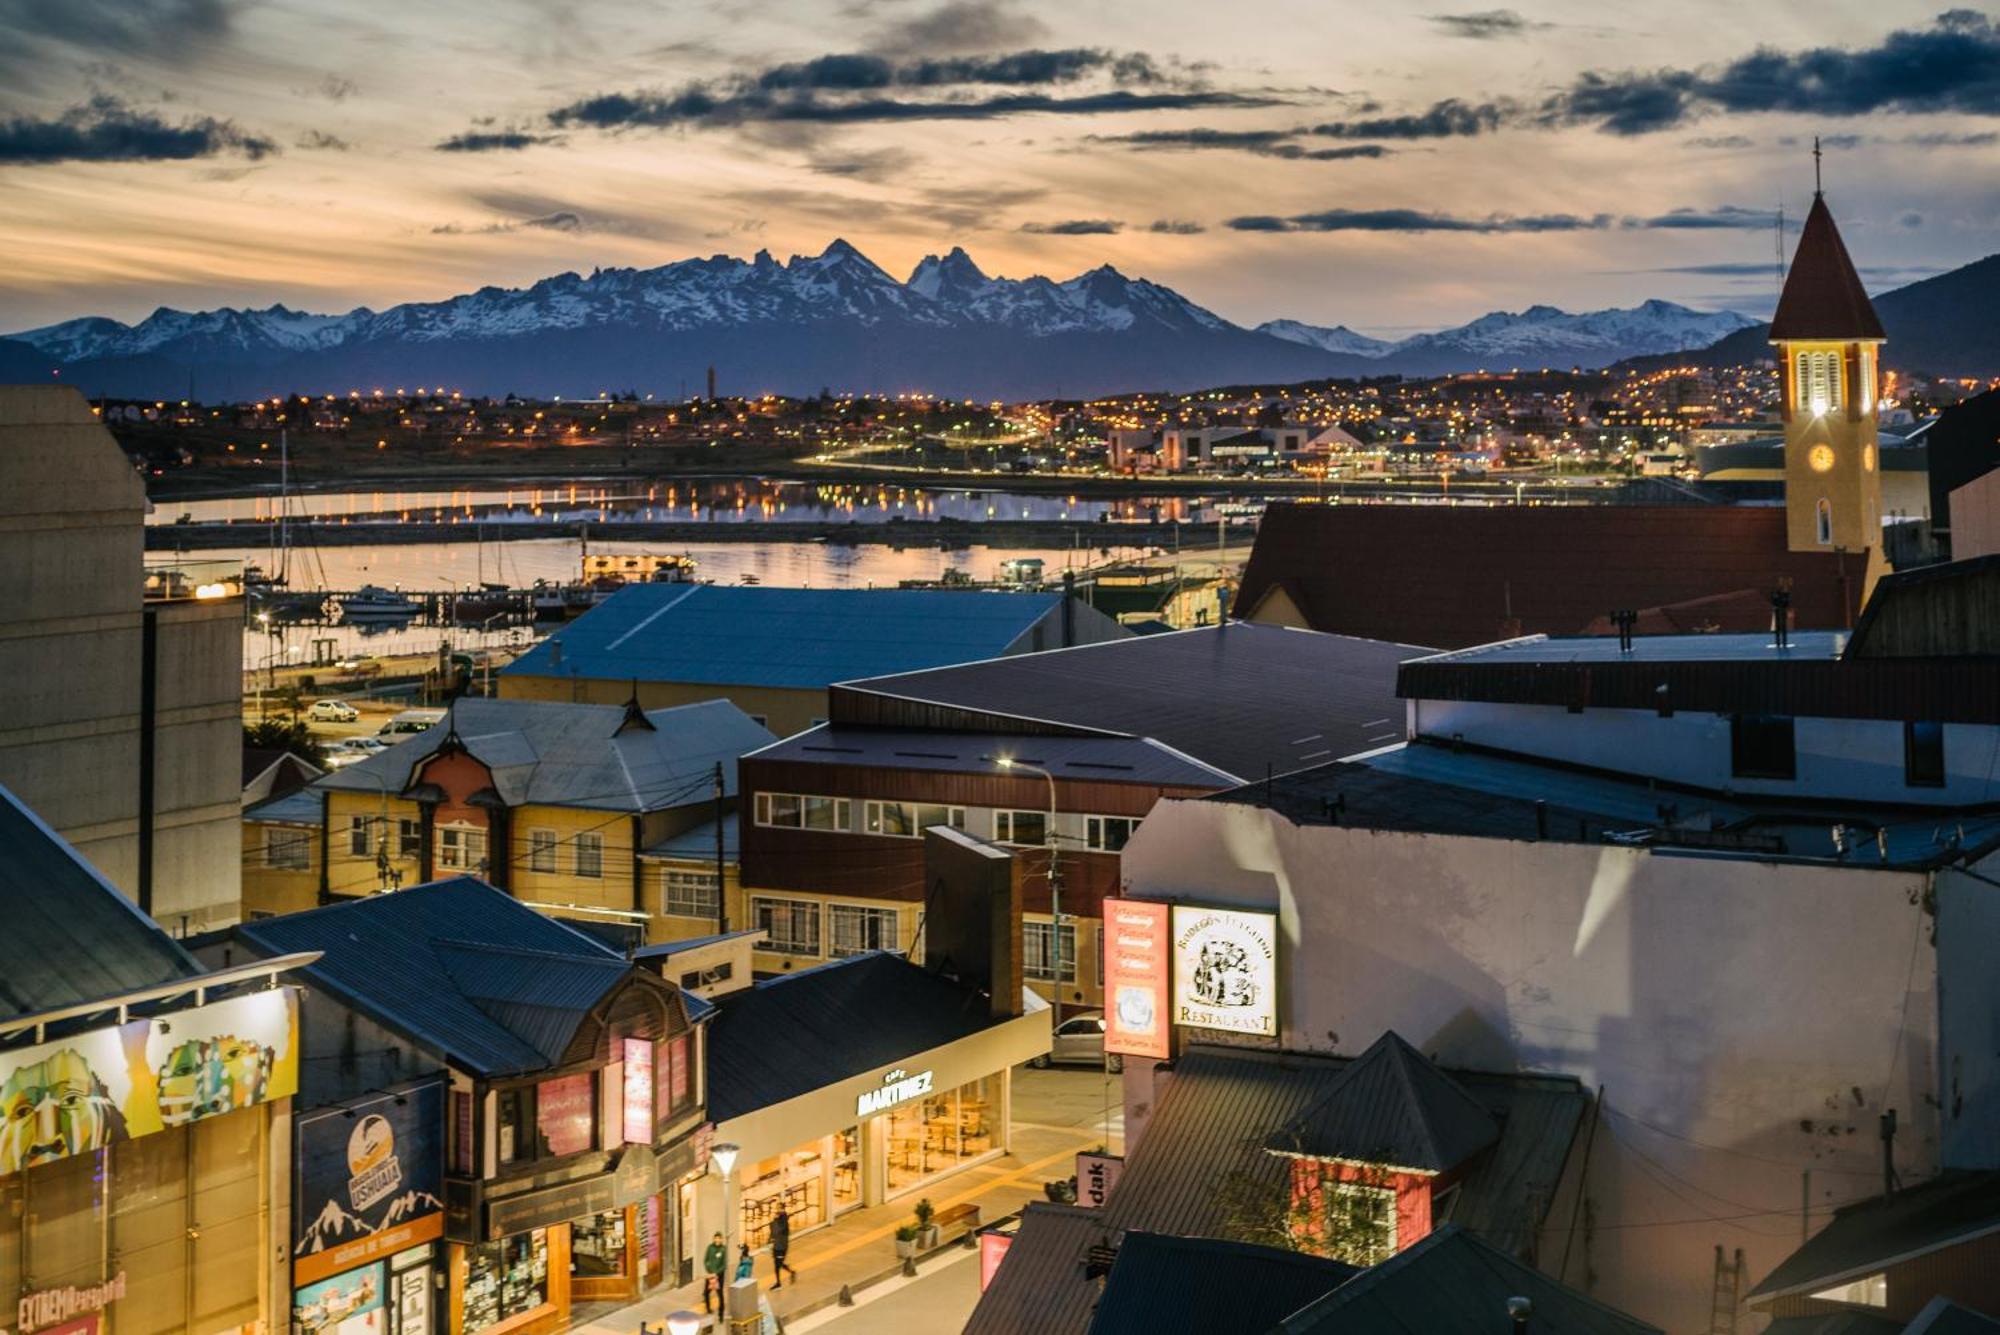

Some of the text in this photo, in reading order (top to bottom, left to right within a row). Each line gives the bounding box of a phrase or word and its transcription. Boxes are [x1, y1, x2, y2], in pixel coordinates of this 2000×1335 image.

[857, 1070, 934, 1116] MARTINEZ
[352, 1164, 400, 1208] USHUAIA
[1088, 1163, 1104, 1207] dak
